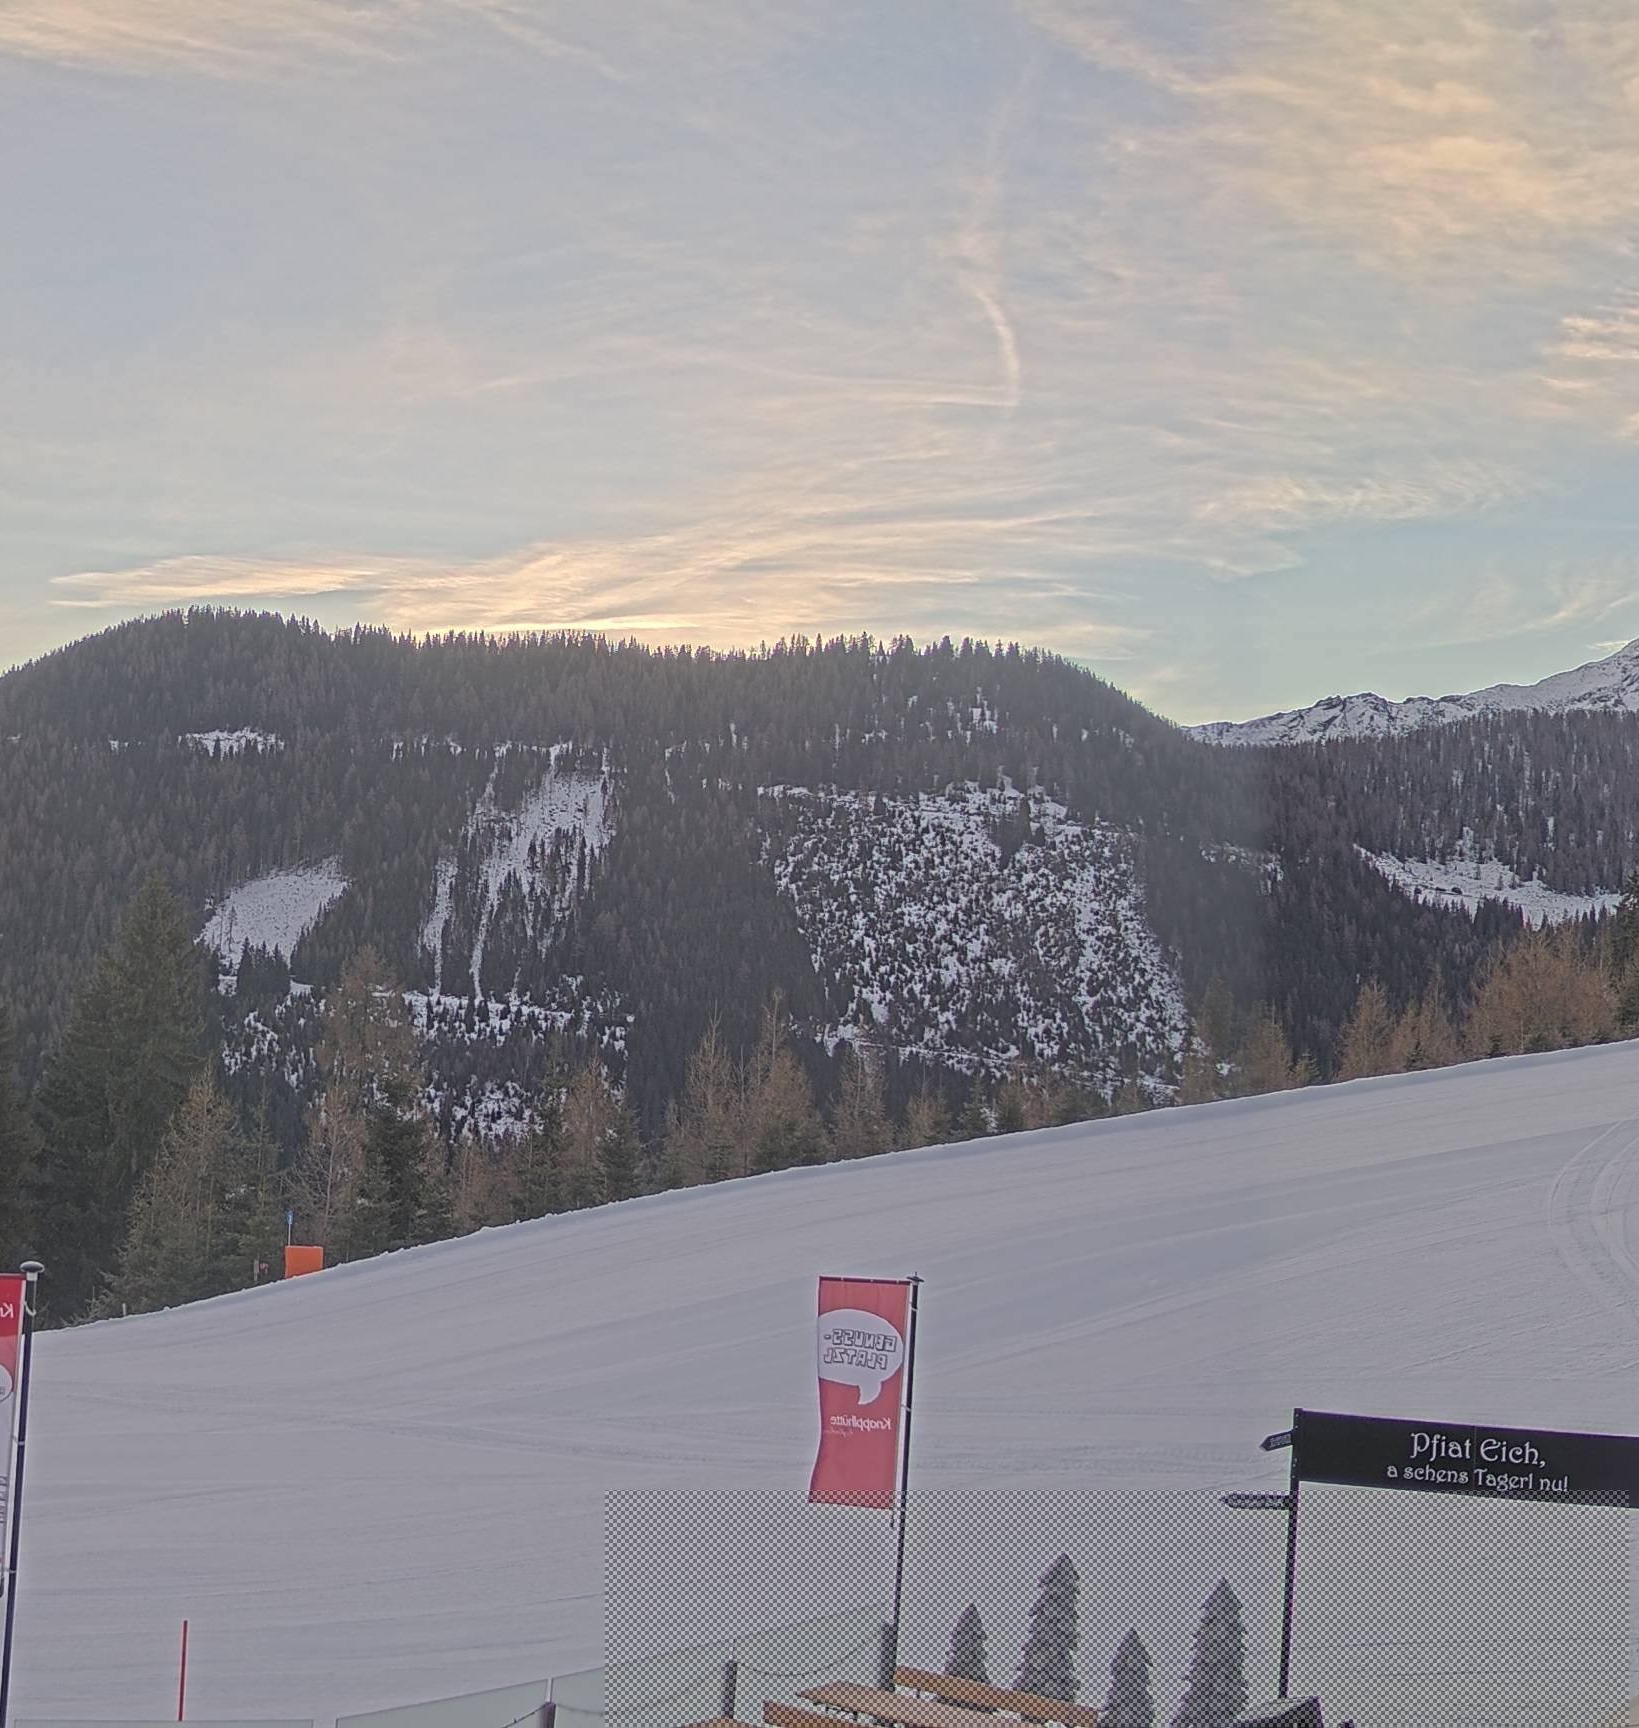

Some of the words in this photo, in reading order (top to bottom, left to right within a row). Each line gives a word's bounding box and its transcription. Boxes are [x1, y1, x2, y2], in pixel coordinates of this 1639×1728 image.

[1409, 1432, 1471, 1462] Pfiat
[1480, 1438, 1546, 1468] Eich,
[1387, 1465, 1398, 1478] a
[1403, 1464, 1469, 1484] schens
[1474, 1468, 1533, 1492] Tagerl
